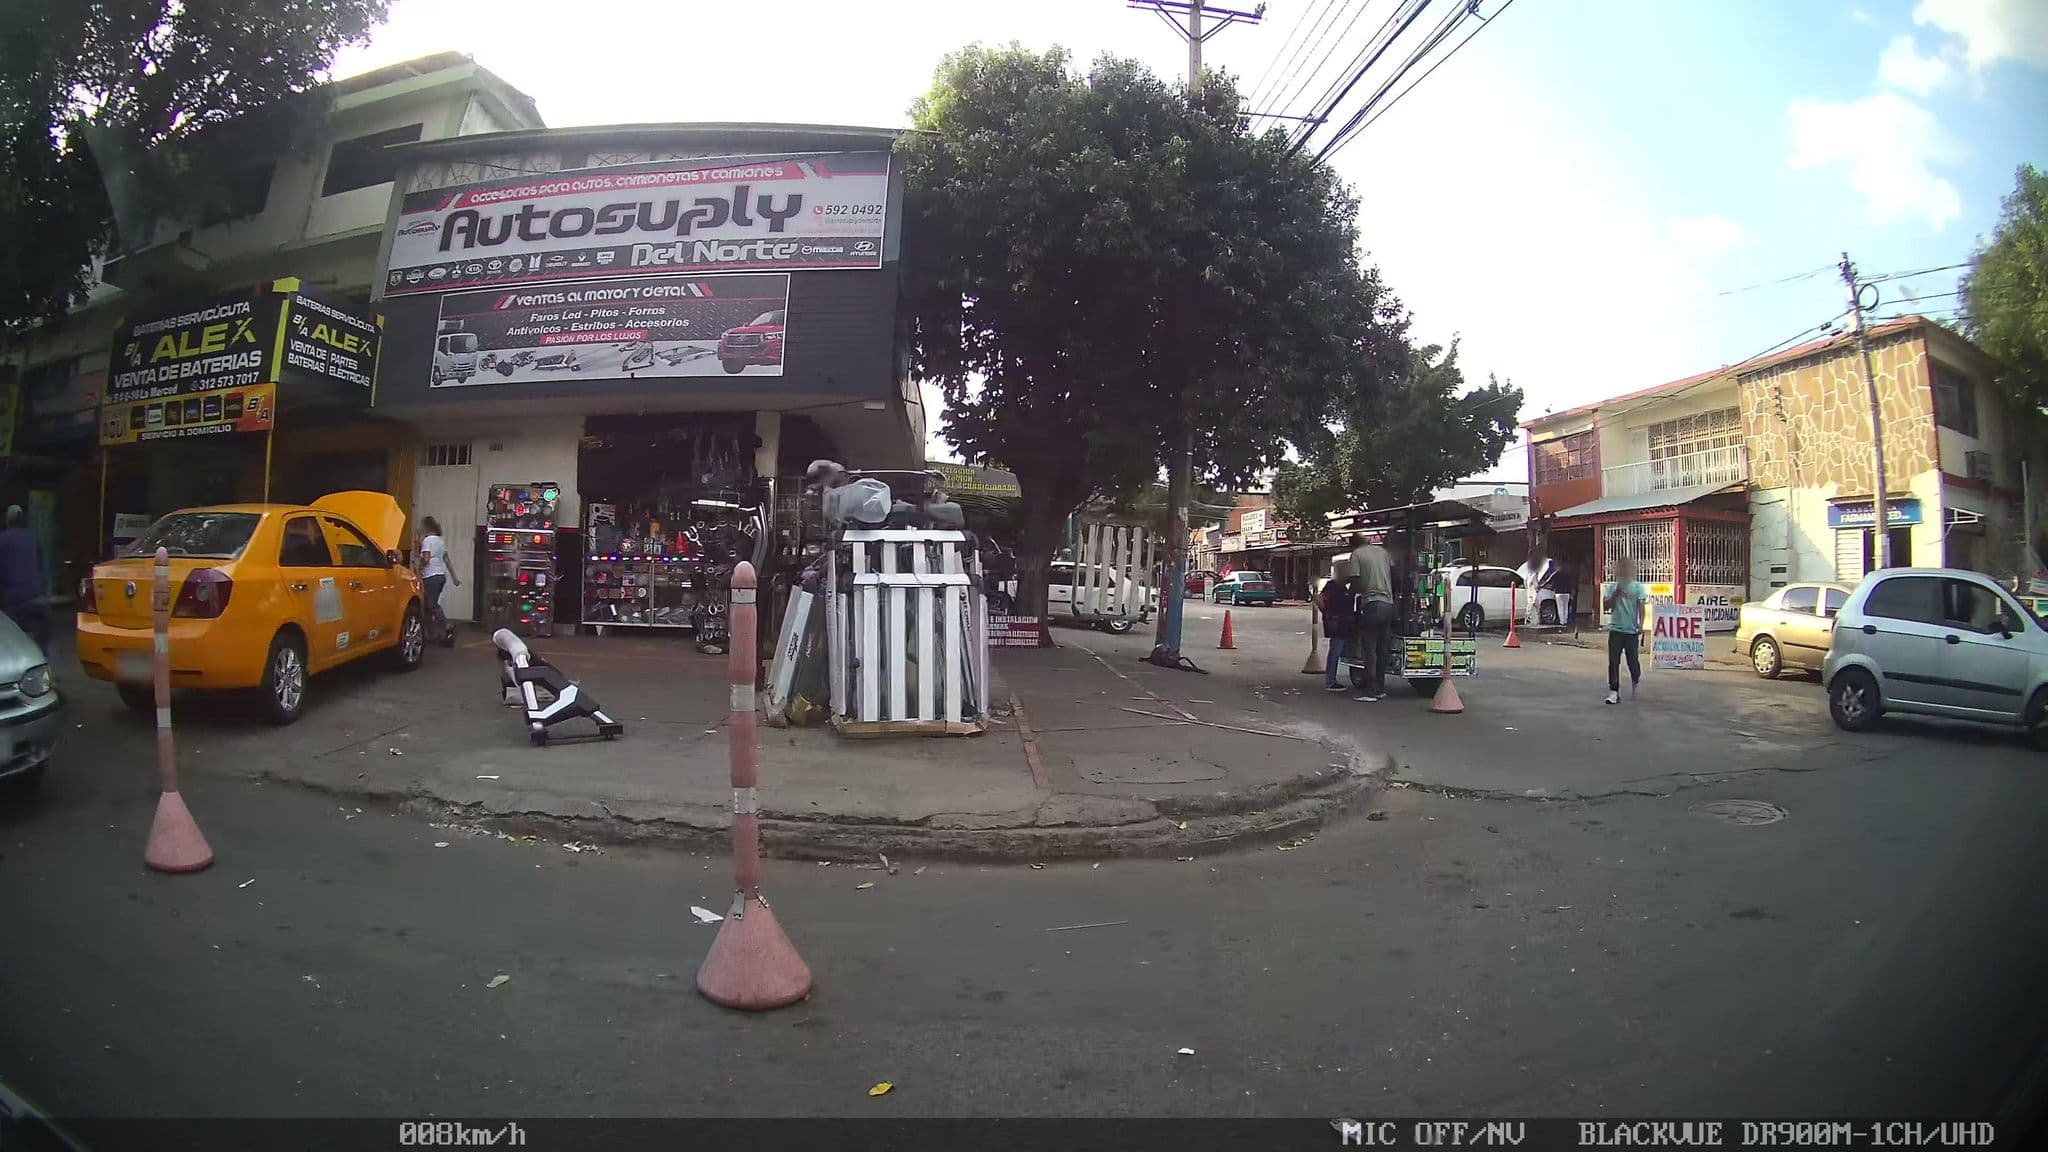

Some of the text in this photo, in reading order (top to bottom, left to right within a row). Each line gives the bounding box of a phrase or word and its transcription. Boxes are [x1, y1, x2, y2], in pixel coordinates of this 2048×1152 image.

[439, 185, 803, 252] Autosuply
[825, 204, 882, 215] 592 0492
[631, 240, 799, 267] Del Norte
[177, 302, 250, 327] SERVICÚCUTA
[530, 306, 666, 323] Faros Led Pitos Forros
[571, 321, 616, 332] Estribos
[625, 318, 690, 329] Accesorios
[150, 317, 257, 363] ALEX
[310, 323, 372, 358] ALEX
[576, 334, 593, 342] POR
[594, 333, 611, 341] LOS
[613, 332, 641, 341] LUJOS
[289, 338, 327, 360] VENTA DE
[115, 350, 263, 388] VENTA DE BATERIAS
[287, 352, 325, 373] BATERIAS
[330, 353, 358, 370] PARTES
[199, 371, 260, 391] 312 573 7017
[329, 365, 370, 387] ELECTRICAS
[141, 429, 177, 441] SERVICIO
[187, 424, 232, 436] DOMICILIO
[1697, 595, 1729, 606] AIRE
[1654, 616, 1703, 639] AIRE
